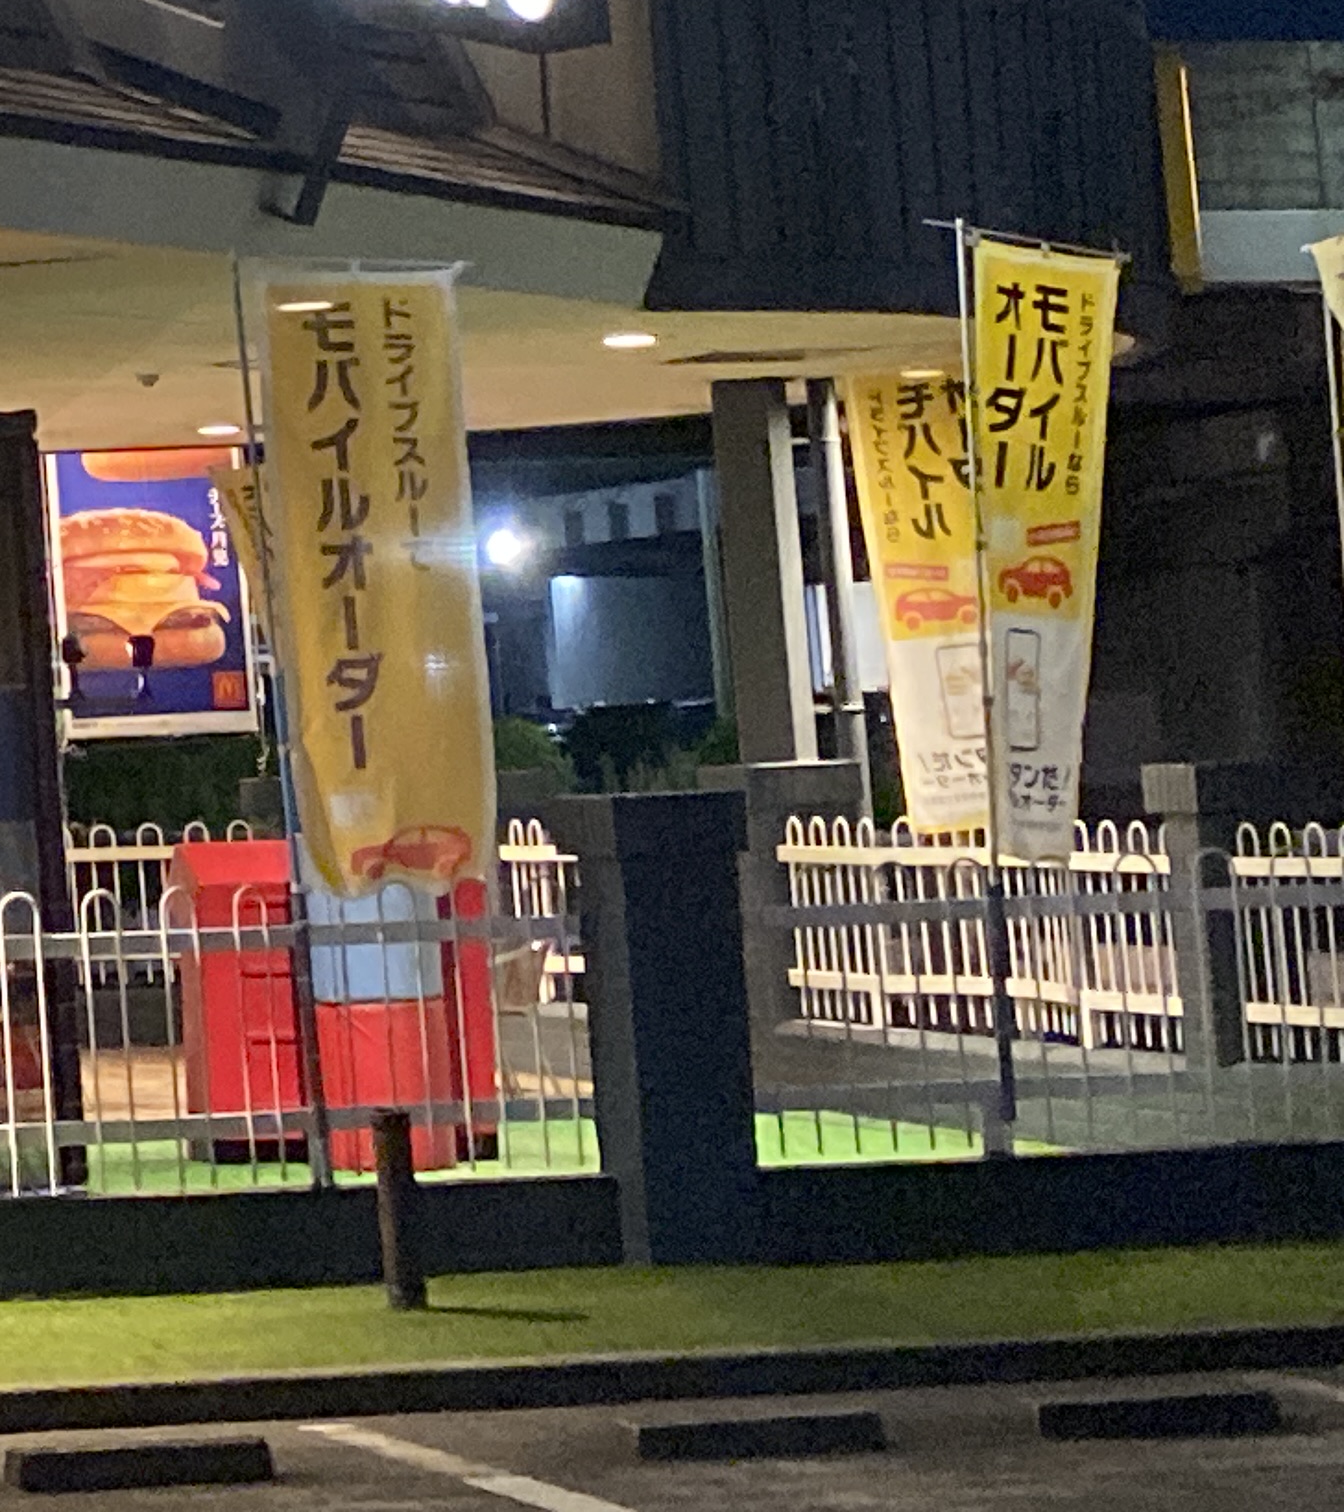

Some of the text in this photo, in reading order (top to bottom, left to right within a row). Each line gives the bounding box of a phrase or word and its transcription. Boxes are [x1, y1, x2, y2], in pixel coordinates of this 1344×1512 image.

[986, 282, 1027, 490] オーダー
[1025, 284, 1070, 492] モバイル
[301, 300, 384, 771] モバイルオーダー
